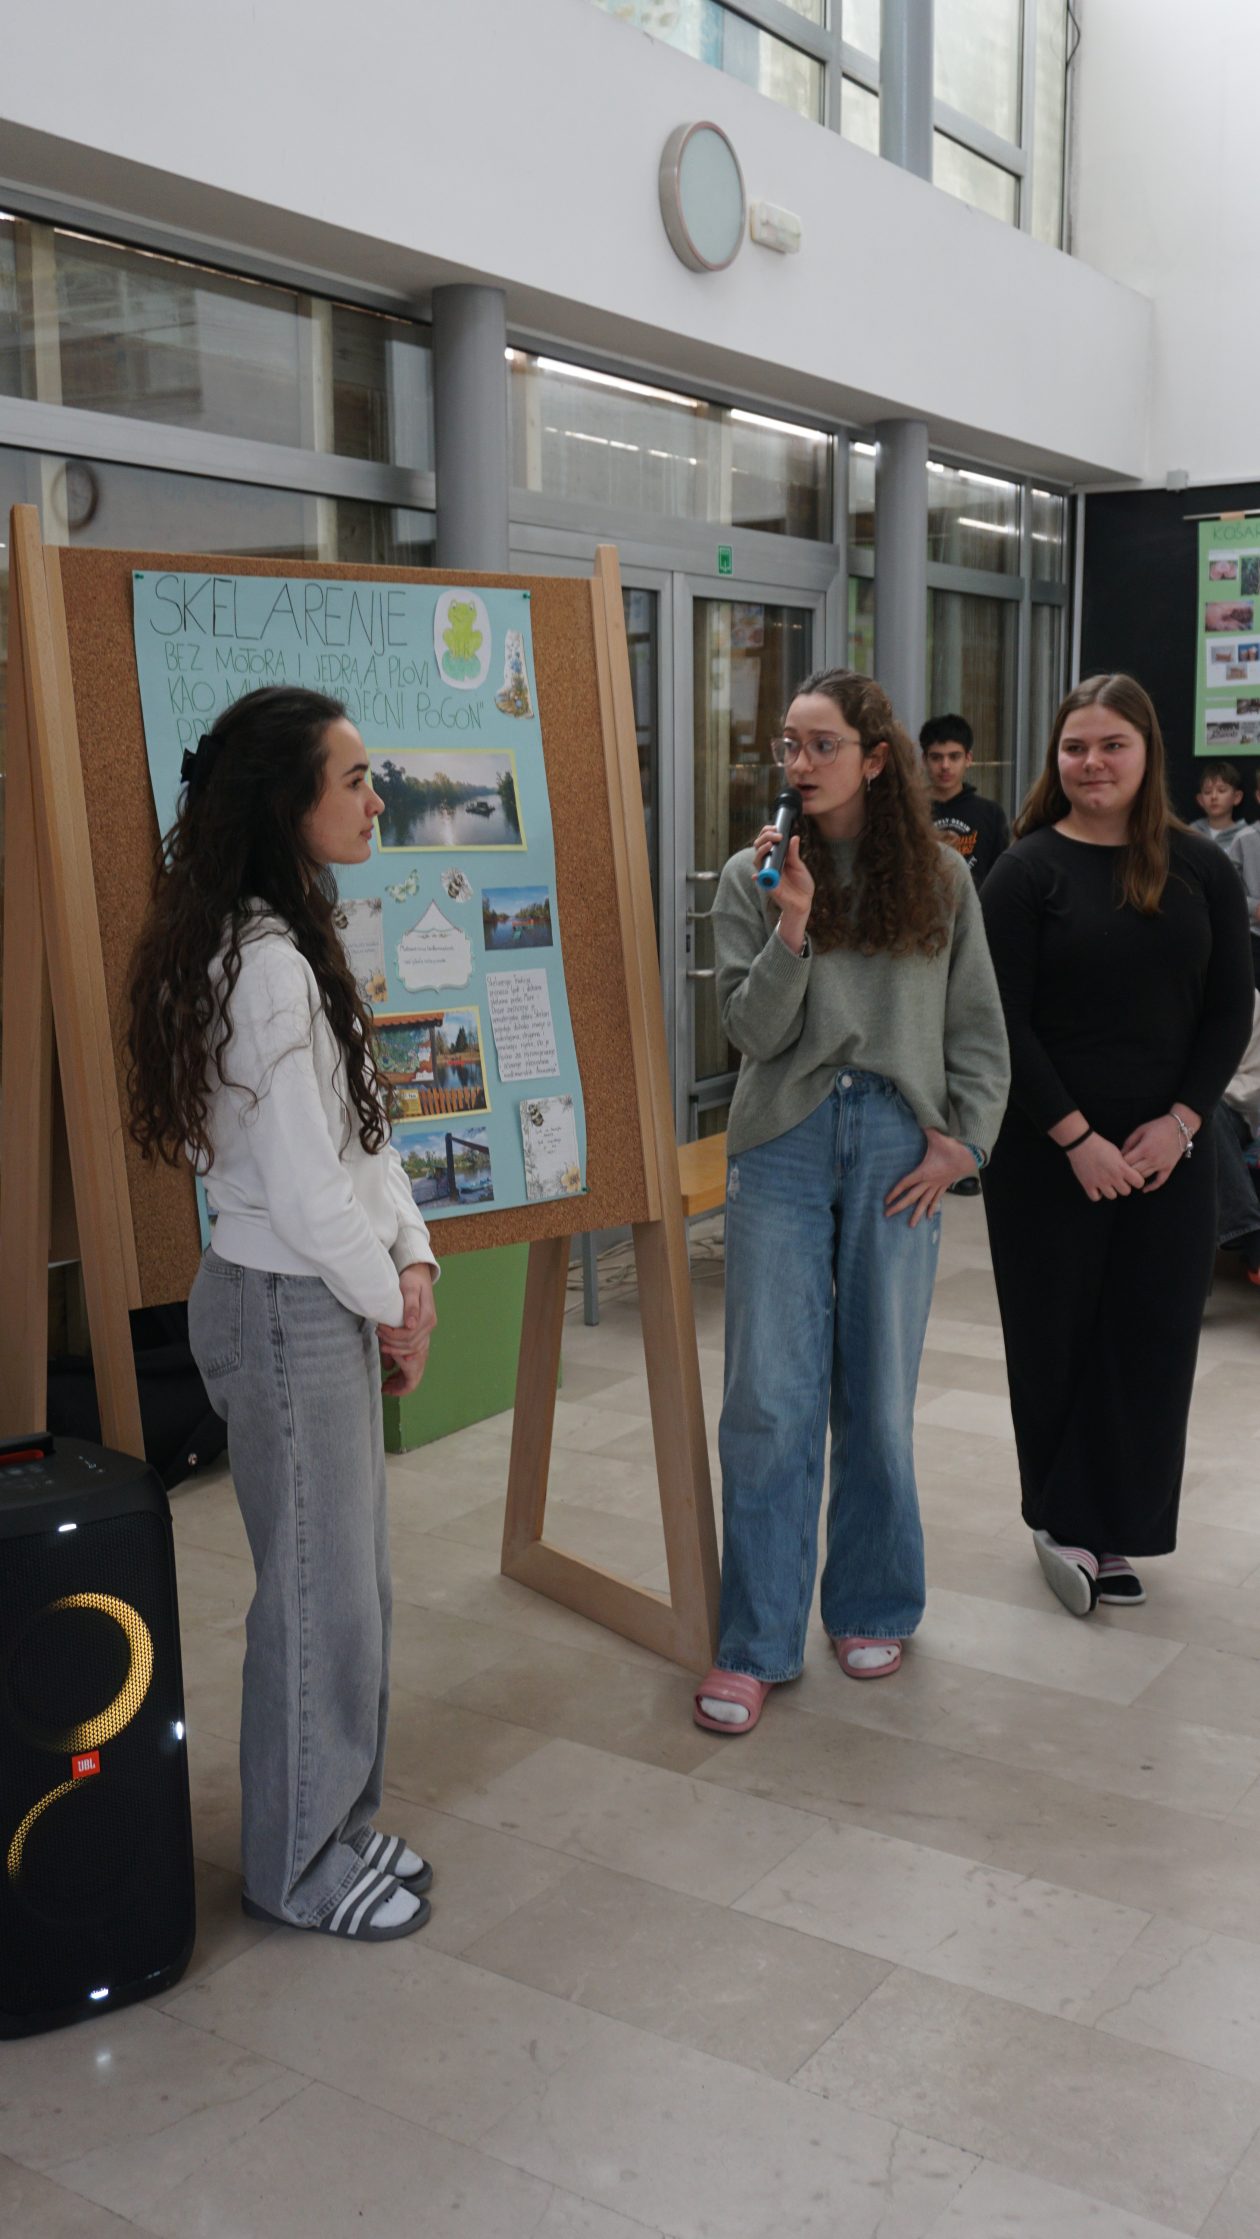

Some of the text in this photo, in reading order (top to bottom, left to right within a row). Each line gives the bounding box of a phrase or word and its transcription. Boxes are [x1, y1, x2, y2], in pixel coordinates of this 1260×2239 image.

[149, 574, 408, 657] SKELARENJE
[164, 640, 430, 689] BEZ MOTORA I JEDRA, A PLOVI
[167, 674, 216, 715] KAO
[416, 690, 484, 732] POGON"
[78, 1757, 96, 1772] JBL
